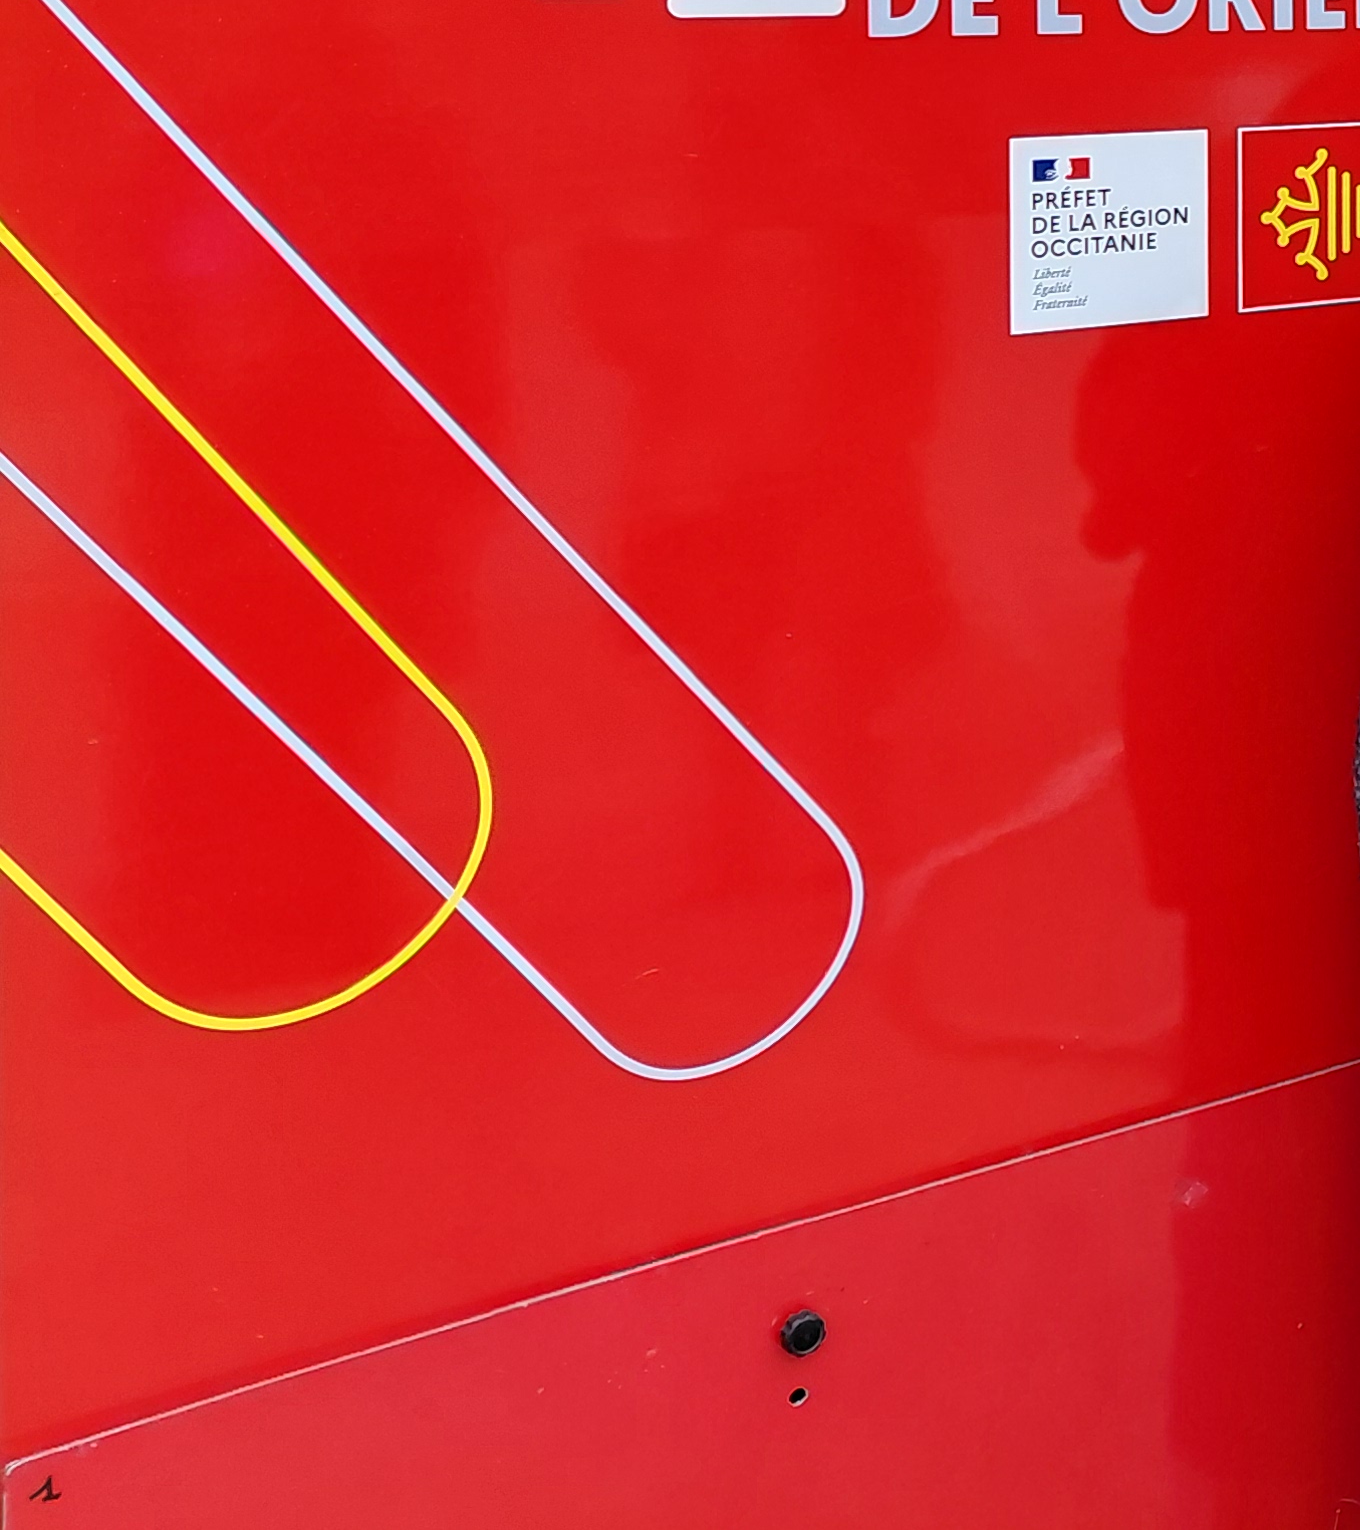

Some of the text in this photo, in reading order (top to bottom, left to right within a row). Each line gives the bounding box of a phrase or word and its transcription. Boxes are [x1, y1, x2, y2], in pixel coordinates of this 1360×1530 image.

[1032, 186, 1111, 210] PRÉFET
[1032, 206, 1189, 234] DE LA RÉGION
[1031, 232, 1157, 258] OCCITANIE
[1033, 266, 1071, 280] Liberté
[1033, 281, 1072, 297] Égalité
[1033, 296, 1088, 311] Fraternité
